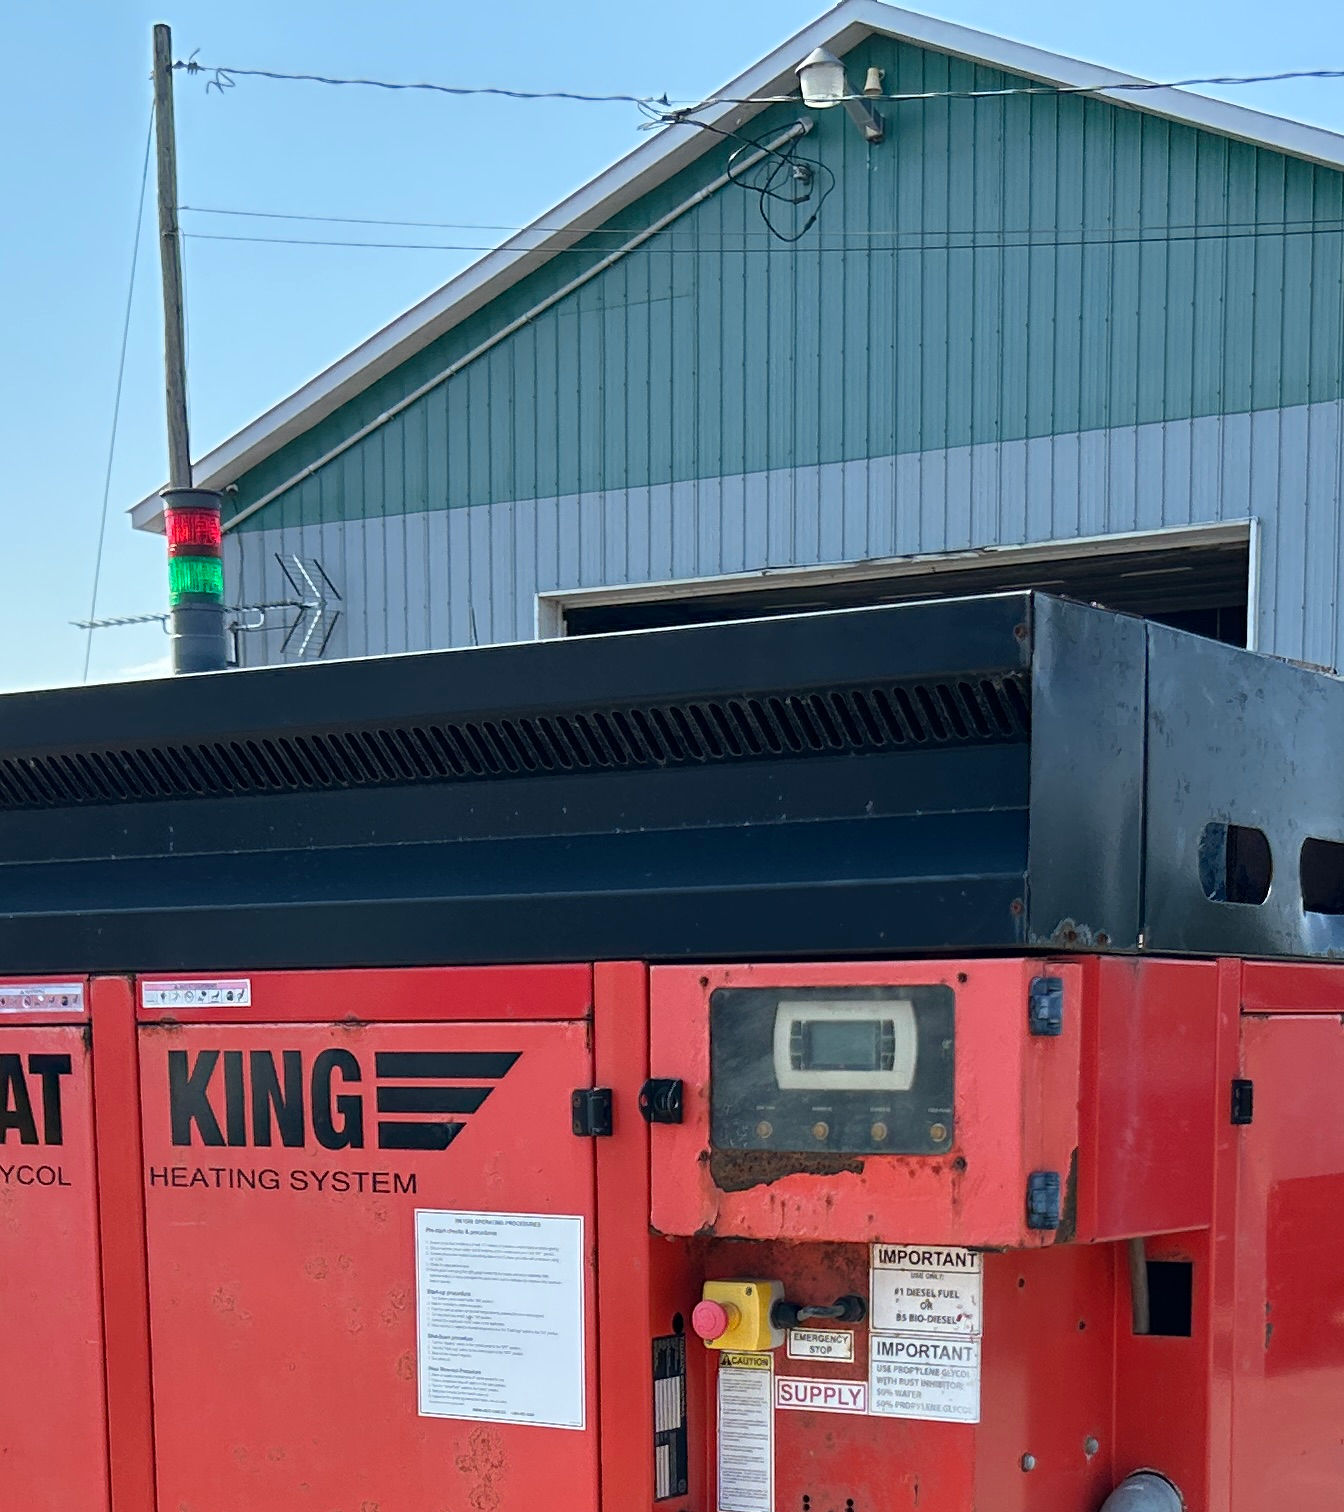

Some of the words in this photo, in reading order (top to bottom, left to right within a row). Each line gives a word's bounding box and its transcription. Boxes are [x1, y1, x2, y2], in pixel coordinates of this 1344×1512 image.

[168, 1048, 364, 1150] KING
[150, 1166, 280, 1191] HEATING
[289, 1169, 418, 1195] SYSTEM
[878, 1248, 978, 1268] IMPORTANT
[906, 1288, 937, 1298] DIESEL
[937, 1289, 960, 1299] FUEL
[919, 1302, 934, 1311] OR
[909, 1313, 958, 1325] BIO-DIESEL
[793, 1333, 849, 1344] EMERGENCY
[809, 1345, 833, 1354] STOP
[876, 1341, 973, 1362] IMPORTANT
[731, 1356, 769, 1367] CAUTION
[876, 1364, 892, 1374] USE
[893, 1365, 940, 1377] PROPYLENE
[876, 1376, 898, 1386] WITH
[898, 1377, 920, 1387] RUST
[780, 1383, 862, 1406] SUPPLY
[894, 1389, 922, 1399] WATER
